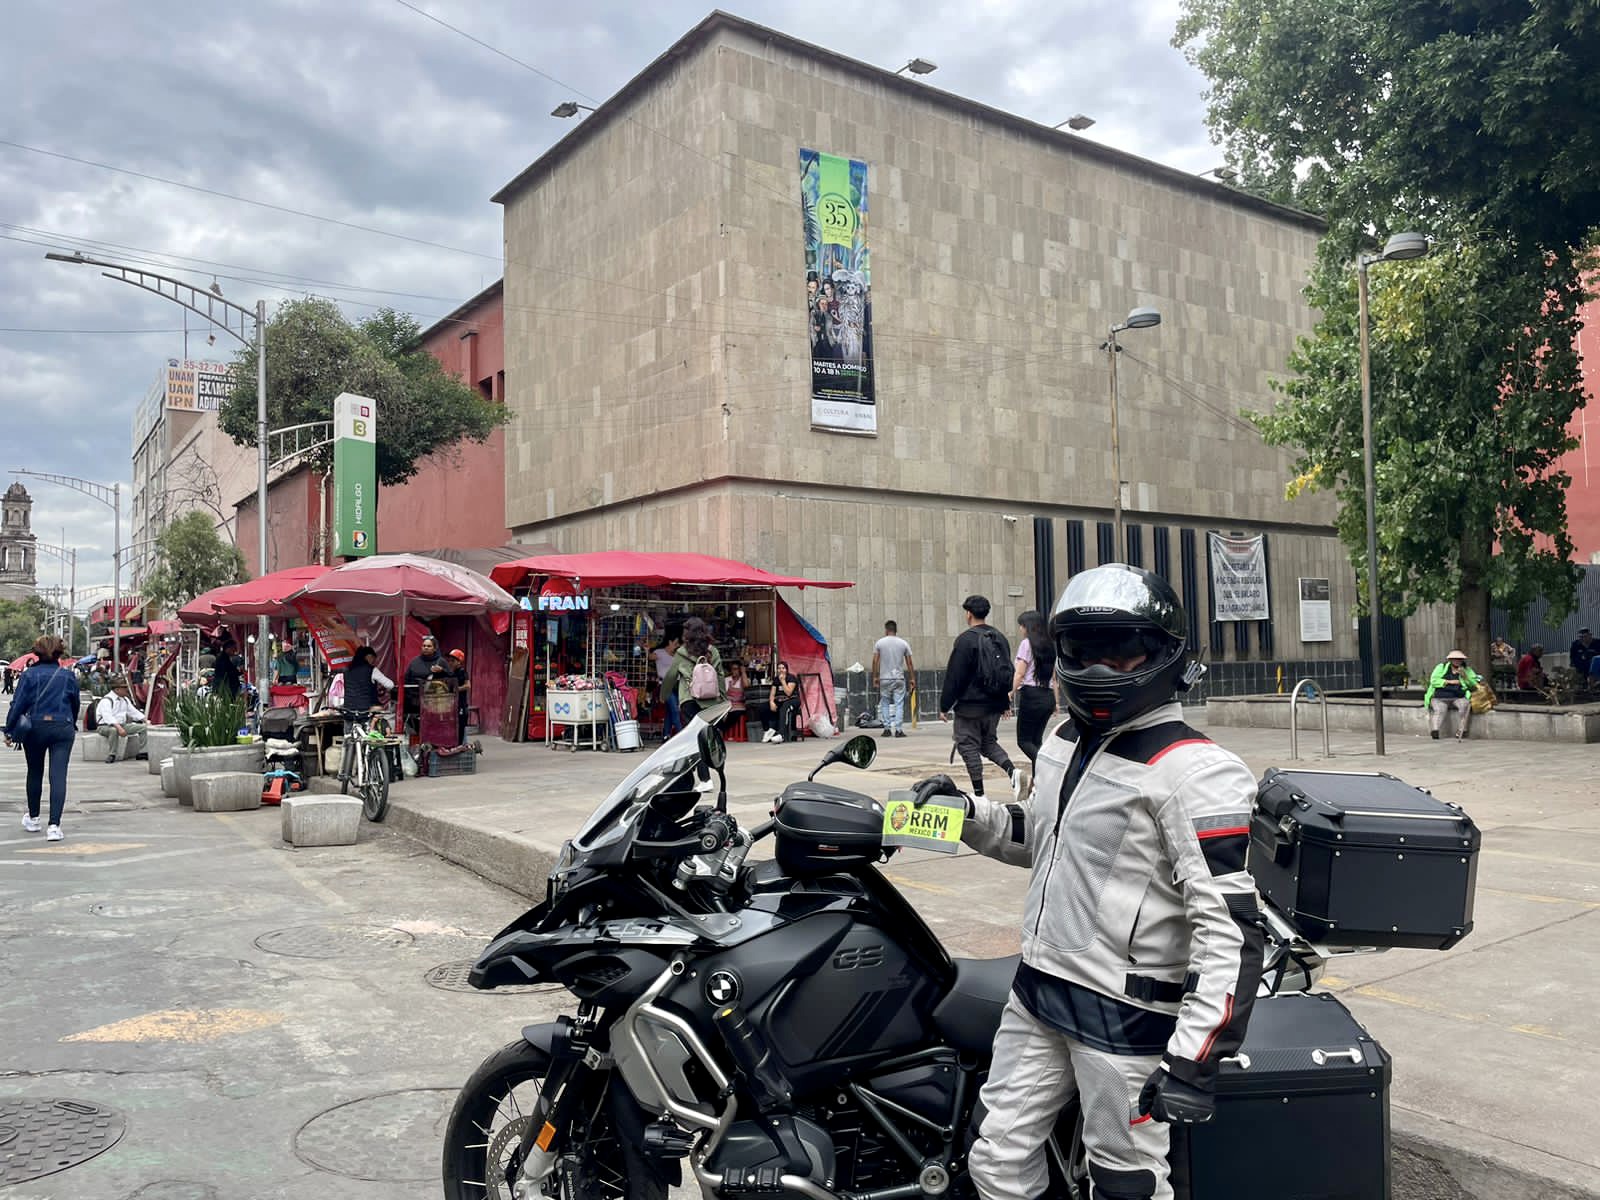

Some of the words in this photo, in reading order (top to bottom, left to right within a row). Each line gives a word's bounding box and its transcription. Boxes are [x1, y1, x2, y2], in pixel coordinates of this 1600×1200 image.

[825, 202, 848, 228] 35
[813, 360, 836, 369] MARTES
[813, 366, 821, 374] 10
[168, 368, 194, 383] UNAM
[168, 383, 194, 395] UAM
[168, 395, 193, 408] IPN
[354, 483, 363, 525] HIDALGO
[538, 595, 589, 611] FRAN
[909, 810, 949, 832] RRM
[832, 944, 885, 973] GS
